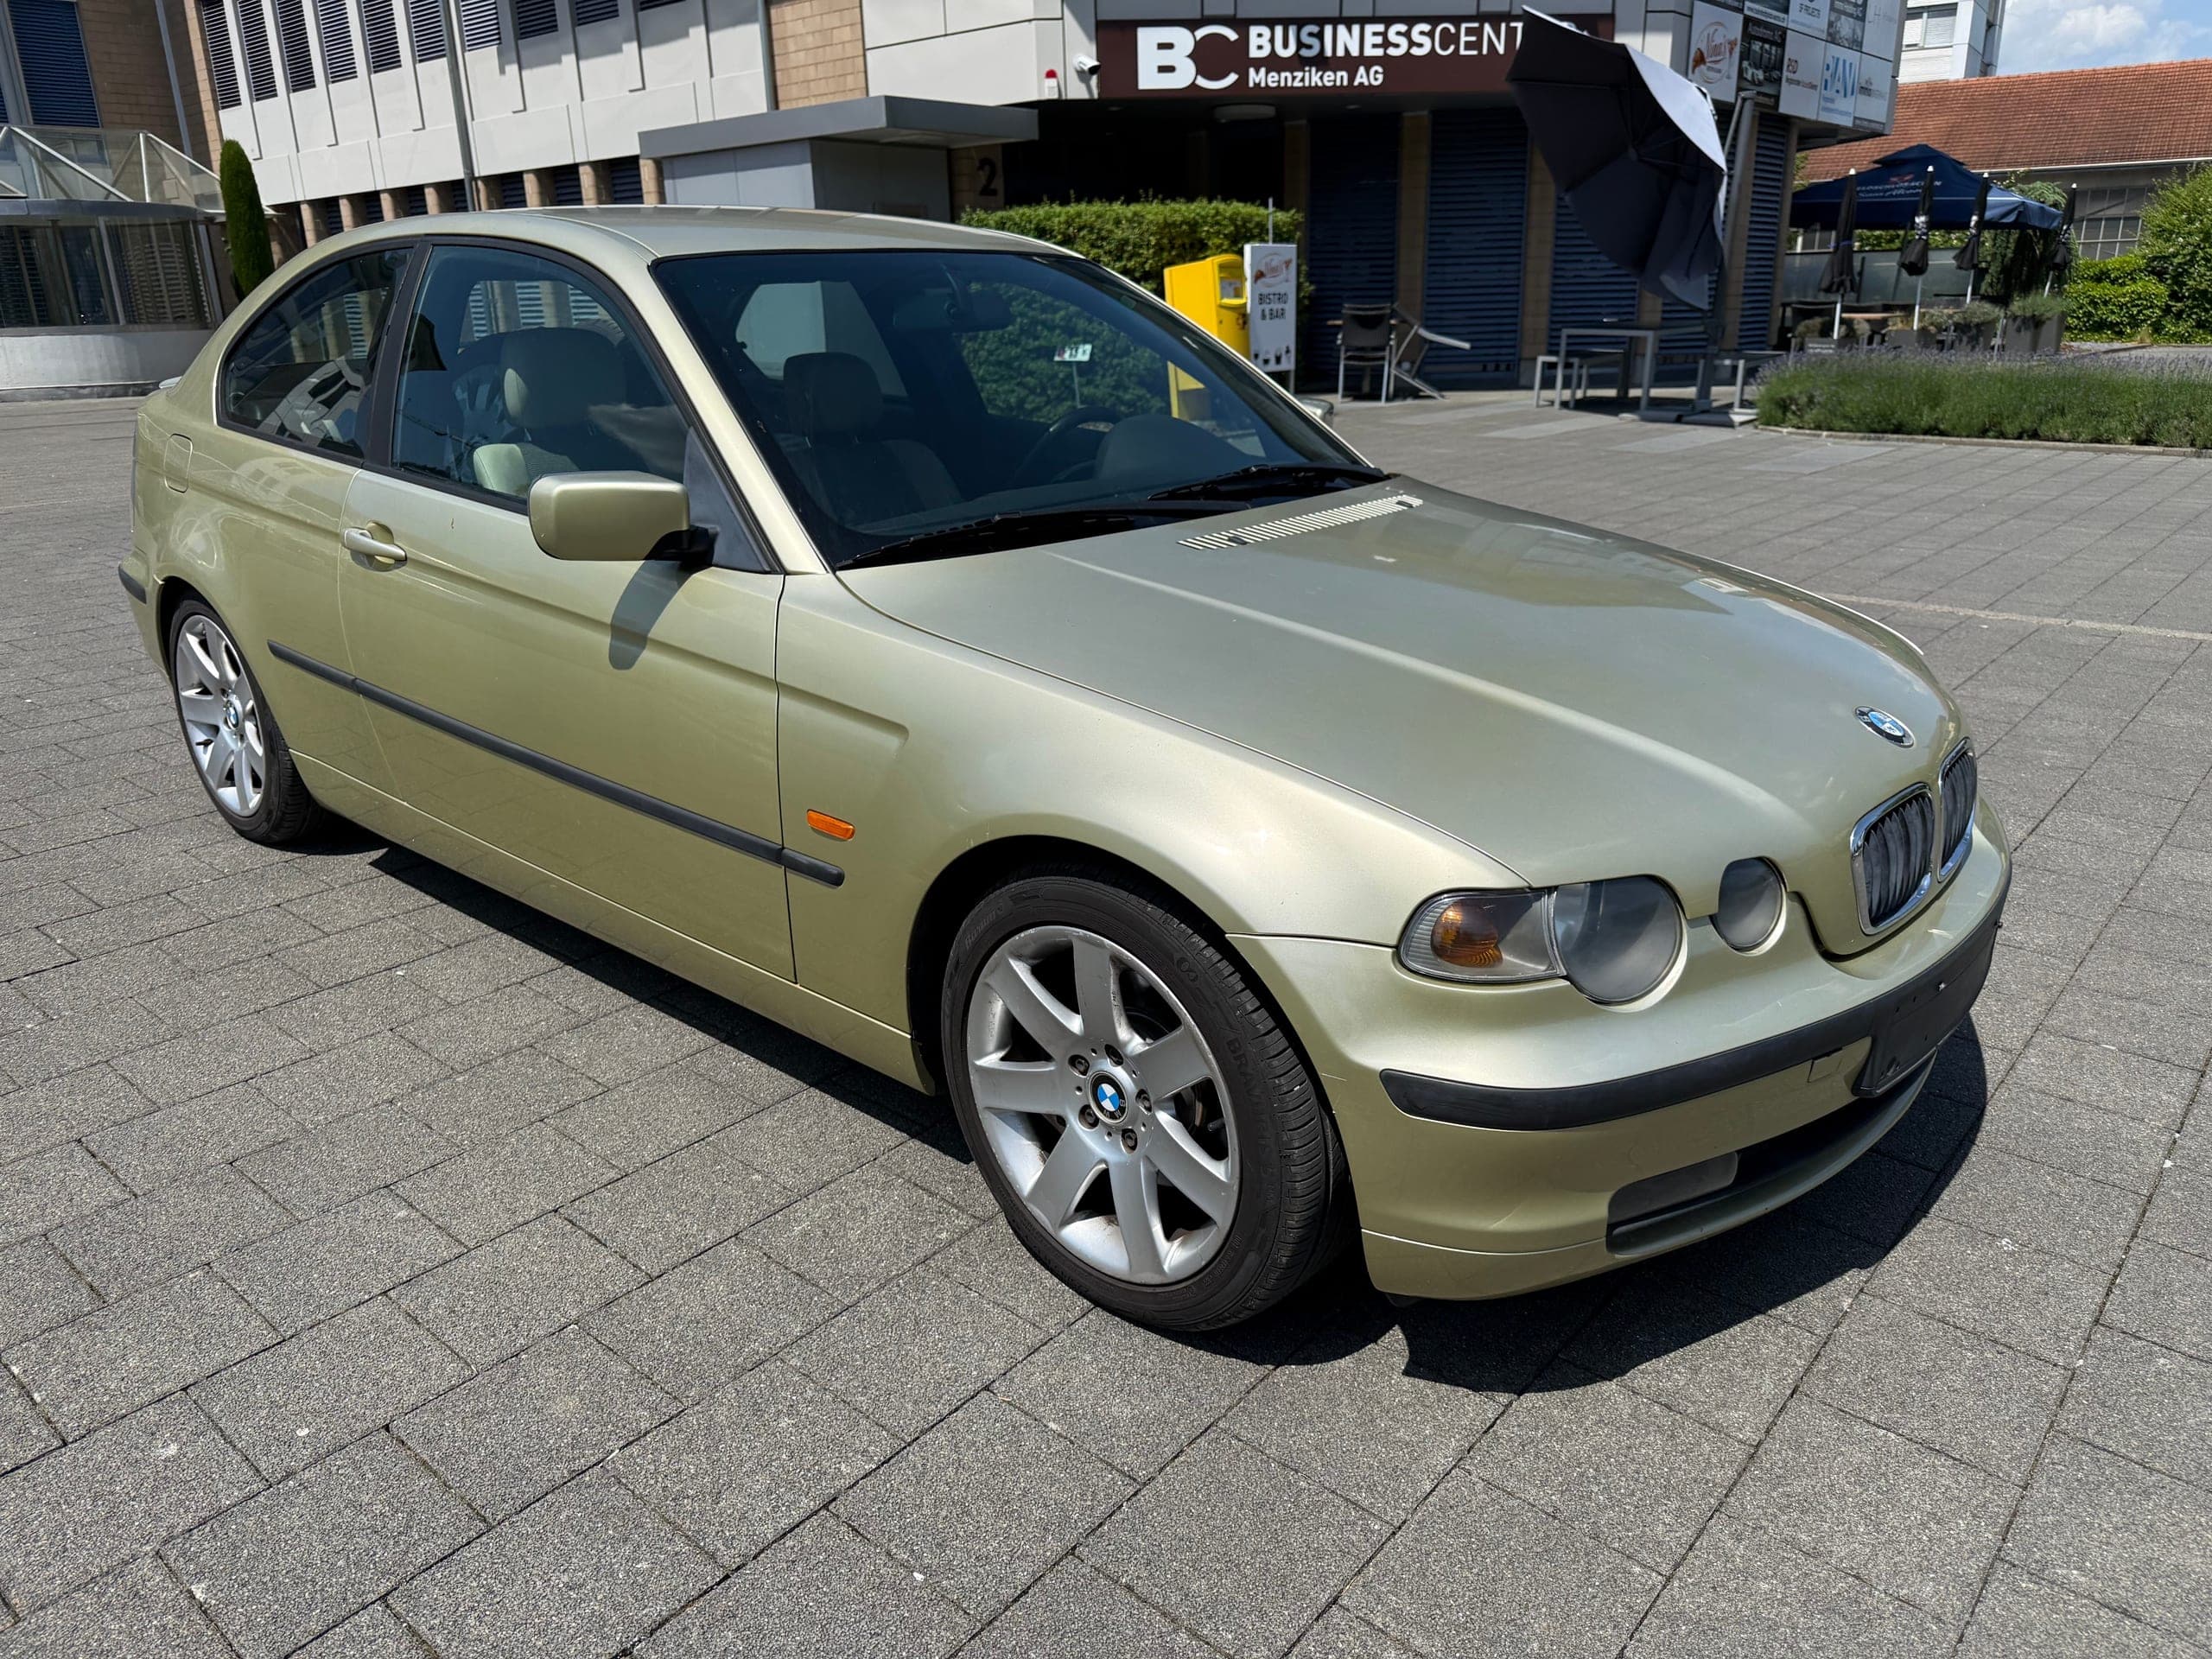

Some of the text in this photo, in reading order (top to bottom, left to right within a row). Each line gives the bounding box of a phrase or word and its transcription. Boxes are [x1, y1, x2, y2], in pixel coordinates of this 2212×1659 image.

[1248, 22, 1590, 59] BUSINESSCENT
[1136, 24, 1239, 90] BC
[1249, 65, 1384, 88] Menziken AG
[976, 157, 998, 197] 2
[1258, 292, 1288, 305] BISTRO
[1269, 308, 1286, 321] BAR
